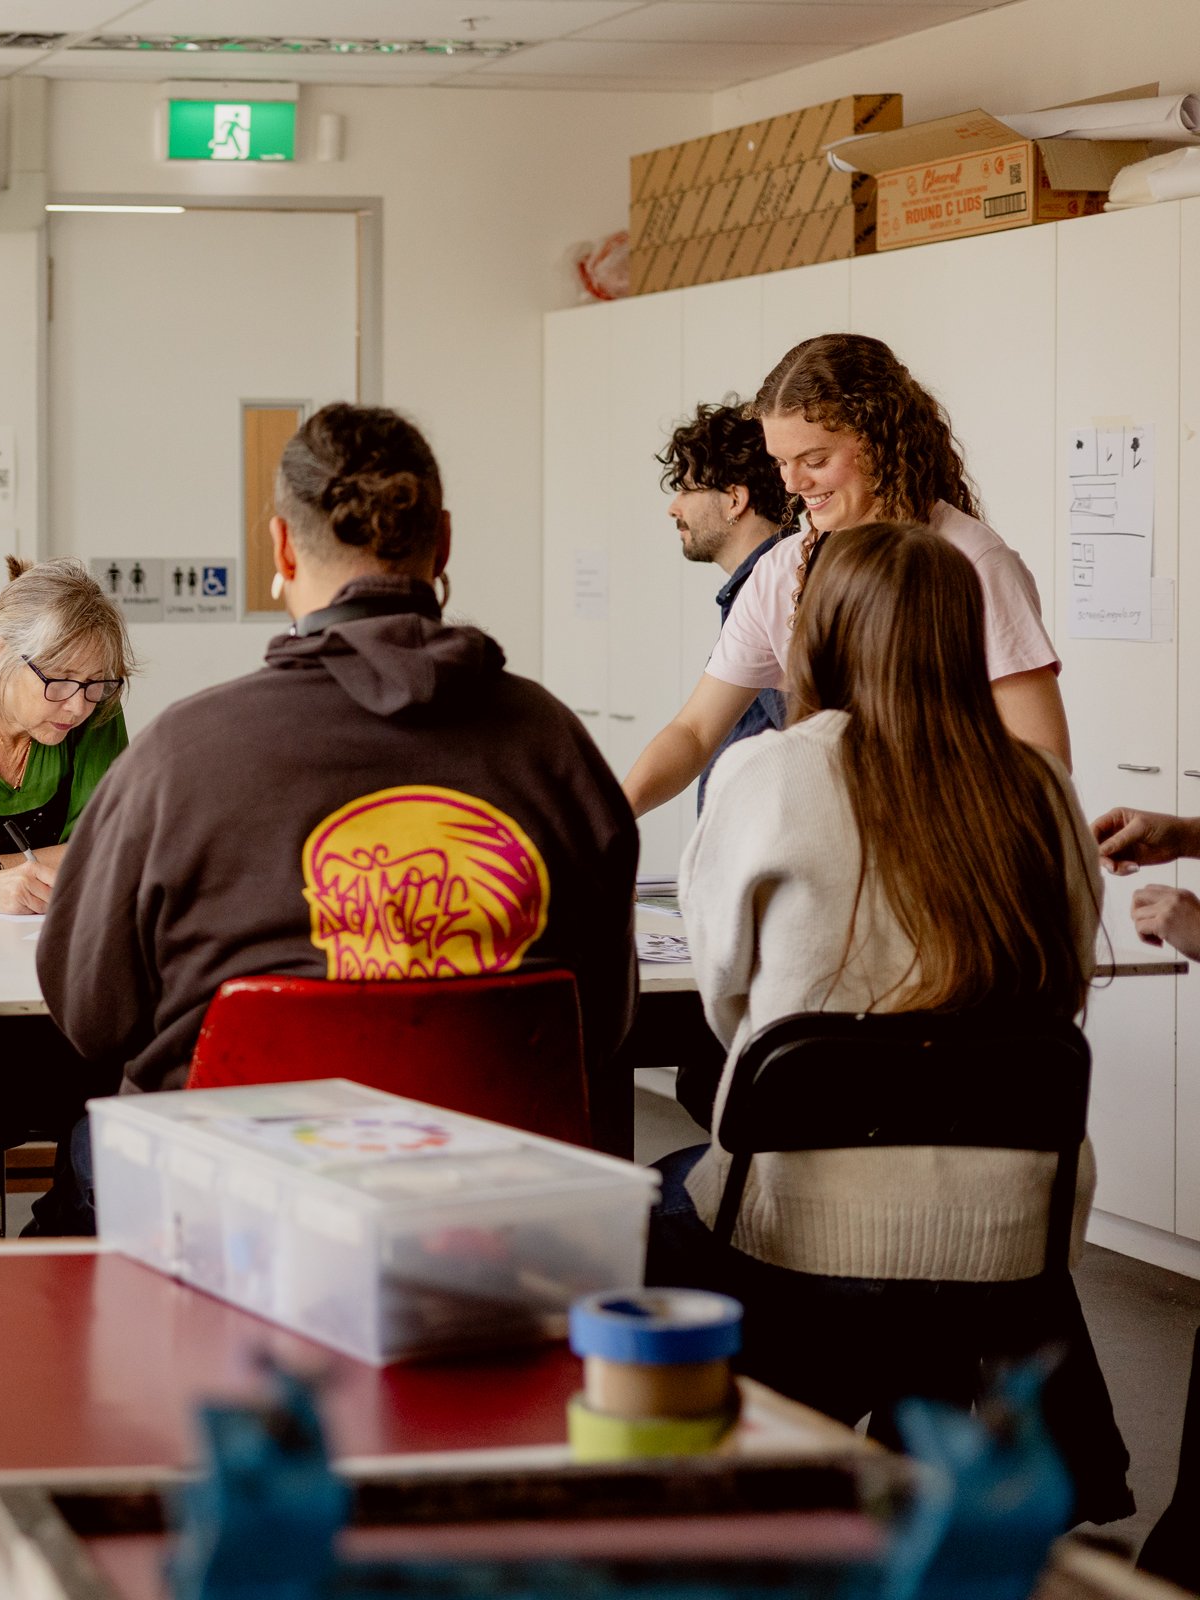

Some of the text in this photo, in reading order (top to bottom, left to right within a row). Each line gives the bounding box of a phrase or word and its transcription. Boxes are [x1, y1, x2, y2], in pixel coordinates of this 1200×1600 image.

[905, 204, 942, 225] ROUND
[945, 202, 953, 216] C
[957, 195, 982, 214] LIDS
